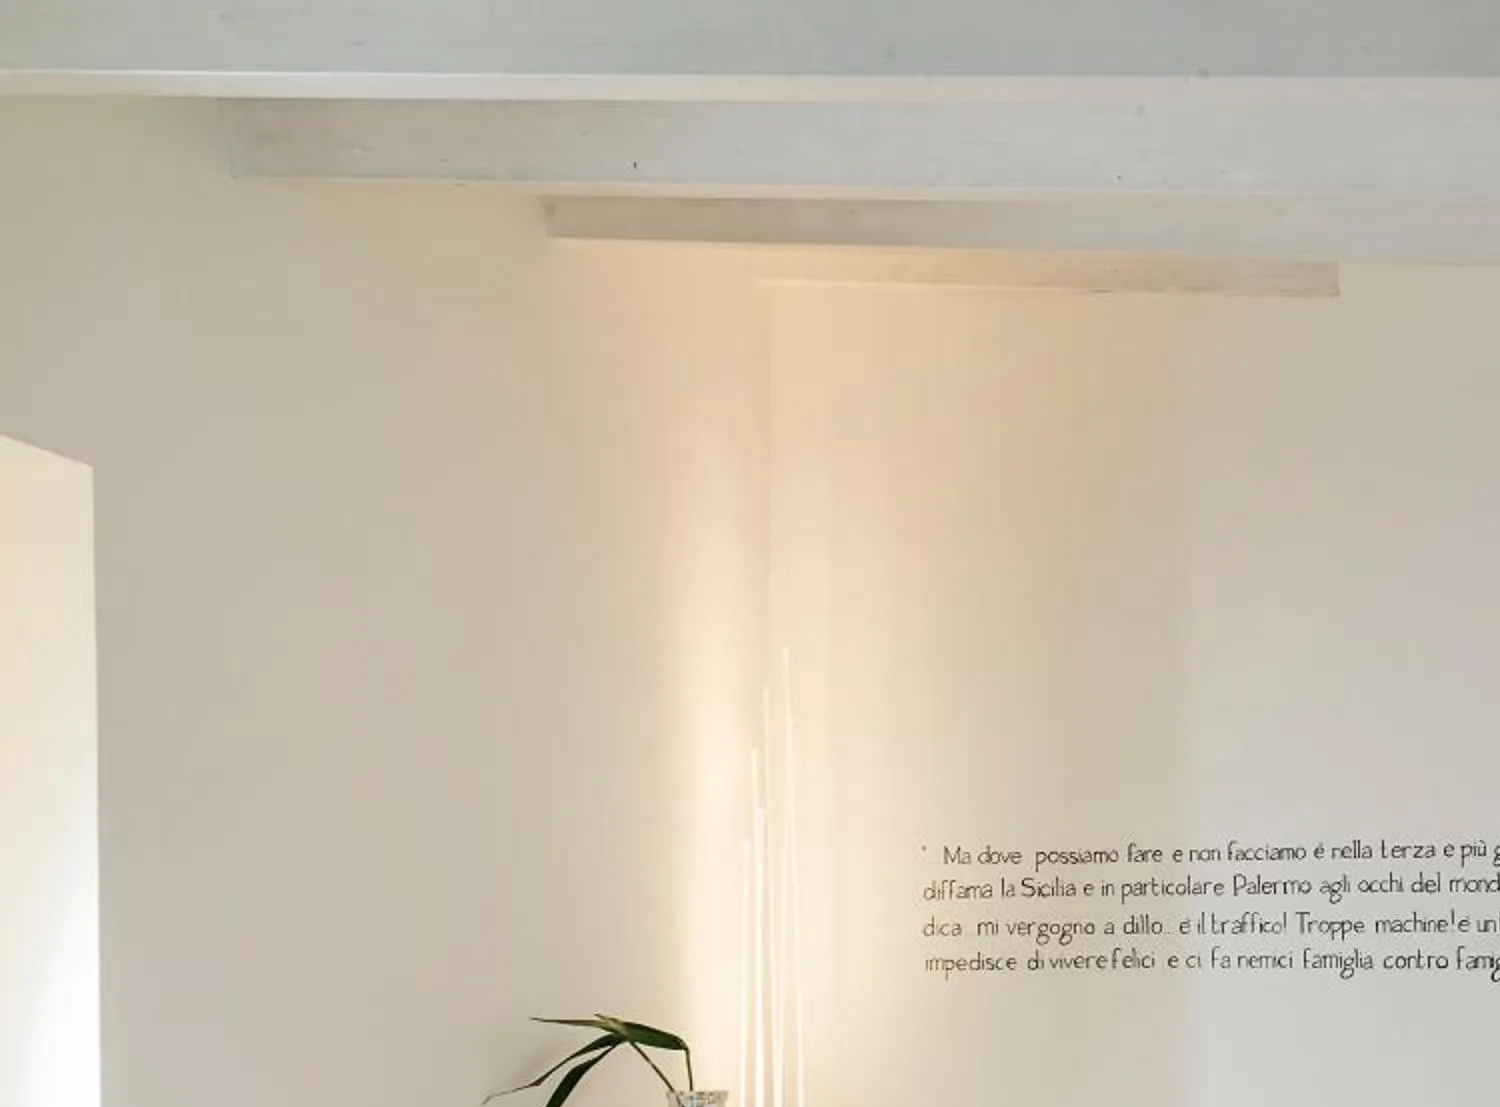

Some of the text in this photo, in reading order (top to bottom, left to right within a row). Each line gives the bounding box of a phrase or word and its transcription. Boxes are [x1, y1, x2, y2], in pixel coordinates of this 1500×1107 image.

[943, 844, 972, 865] Ma
[977, 844, 1022, 865] dove
[1035, 849, 1119, 873] possiamo
[1127, 841, 1163, 863] fare
[1171, 847, 1184, 863] e
[1188, 848, 1221, 862] non
[1227, 840, 1307, 862] facciamo
[1331, 839, 1373, 860] nella
[1380, 839, 1436, 860] terza
[1460, 839, 1487, 868] più
[922, 879, 993, 901] diffama
[1001, 876, 1016, 898] la
[1020, 876, 1077, 898] Sicilia
[1083, 882, 1095, 897] e
[1101, 879, 1115, 897] in
[1120, 874, 1225, 905] particolare
[1232, 873, 1312, 897] Palermo
[1319, 873, 1351, 905] agli
[1357, 870, 1405, 894] occhi
[1411, 870, 1441, 894] del
[977, 920, 999, 936] mi
[1006, 919, 1096, 946] vergogno
[1103, 920, 1115, 935] a
[1197, 911, 1208, 935] il
[1295, 911, 1365, 941] Troppe
[925, 951, 1018, 981] impedisce
[1027, 948, 1045, 971] di
[1048, 953, 1108, 970] vivere
[1111, 946, 1155, 970] felici
[1167, 954, 1179, 969] e
[1184, 954, 1202, 969] ci
[1211, 945, 1231, 969] fa
[1237, 949, 1294, 969] nemici
[1303, 947, 1374, 980] famiglia
[1383, 948, 1449, 970] contro
